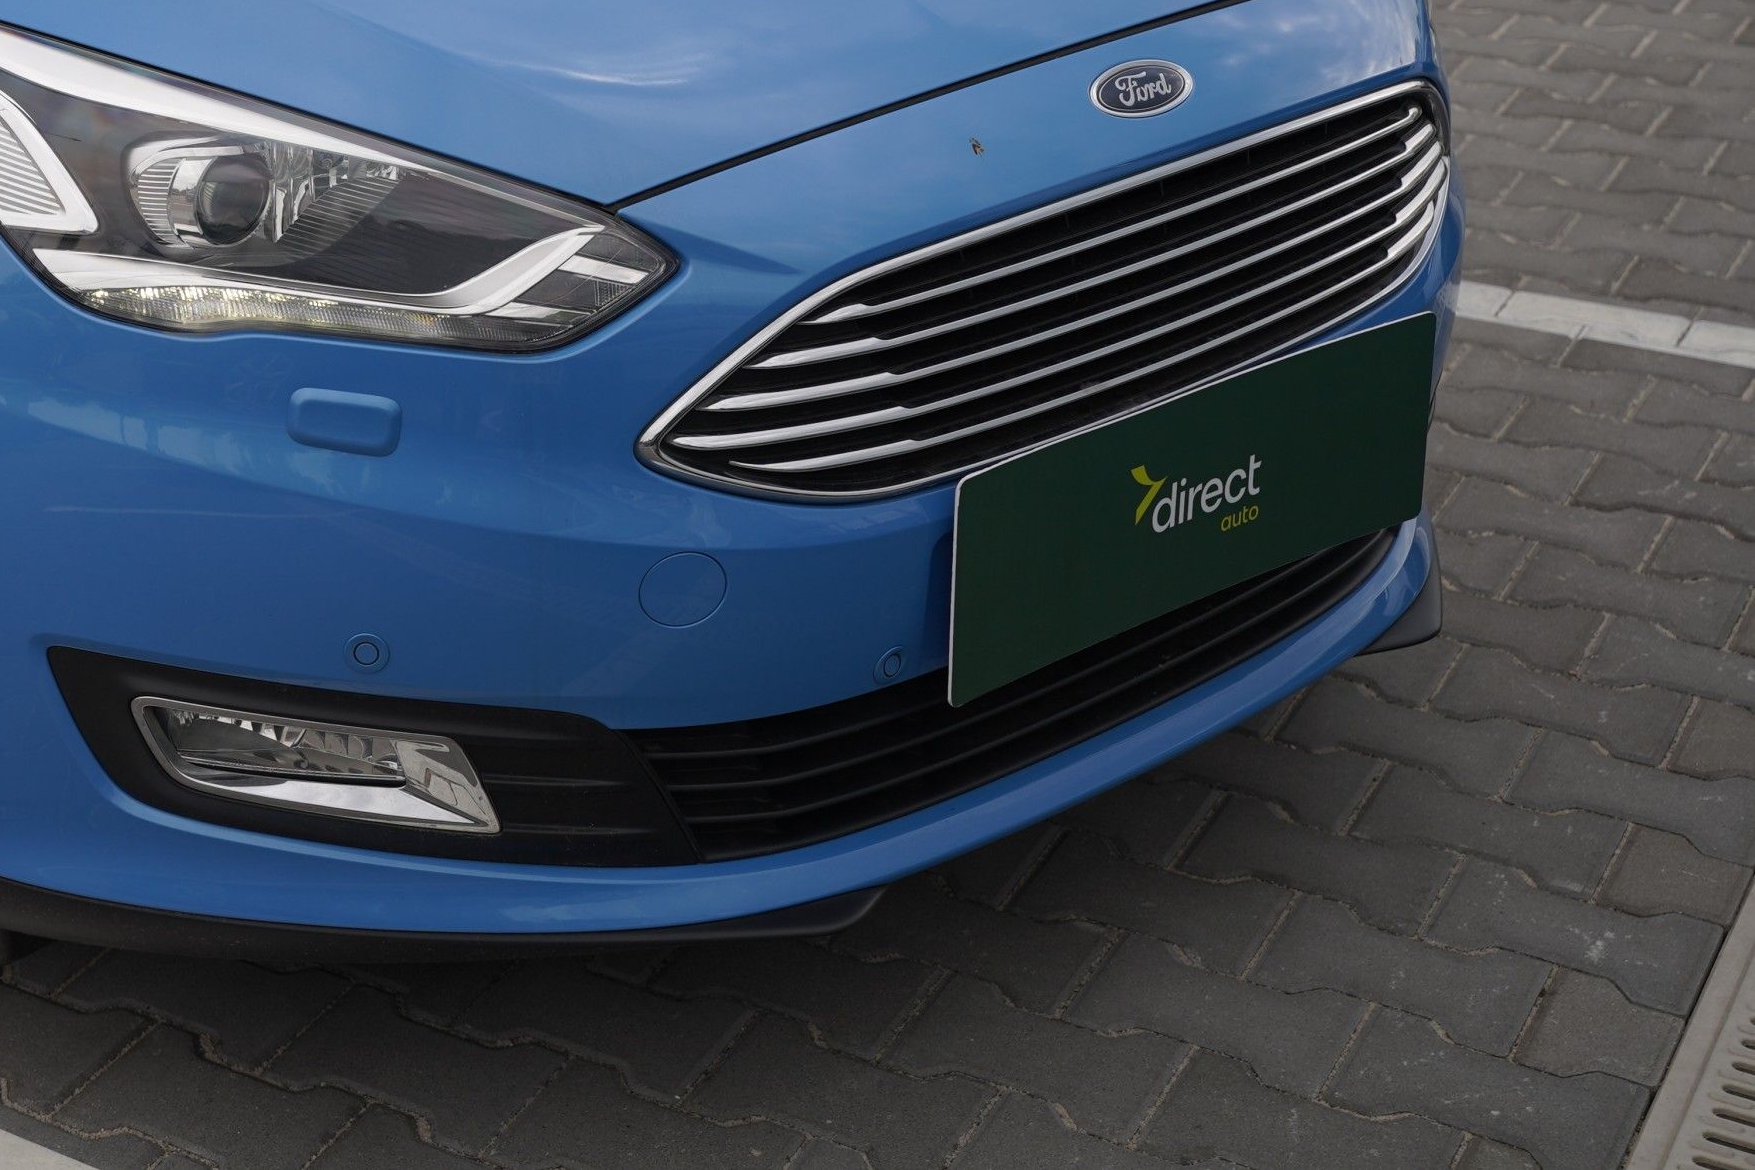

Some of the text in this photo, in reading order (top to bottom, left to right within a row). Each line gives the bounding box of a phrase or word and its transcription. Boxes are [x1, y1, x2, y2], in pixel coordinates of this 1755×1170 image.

[1114, 71, 1172, 106] Ford
[1151, 454, 1262, 533] direct
[1220, 504, 1259, 532] auto
